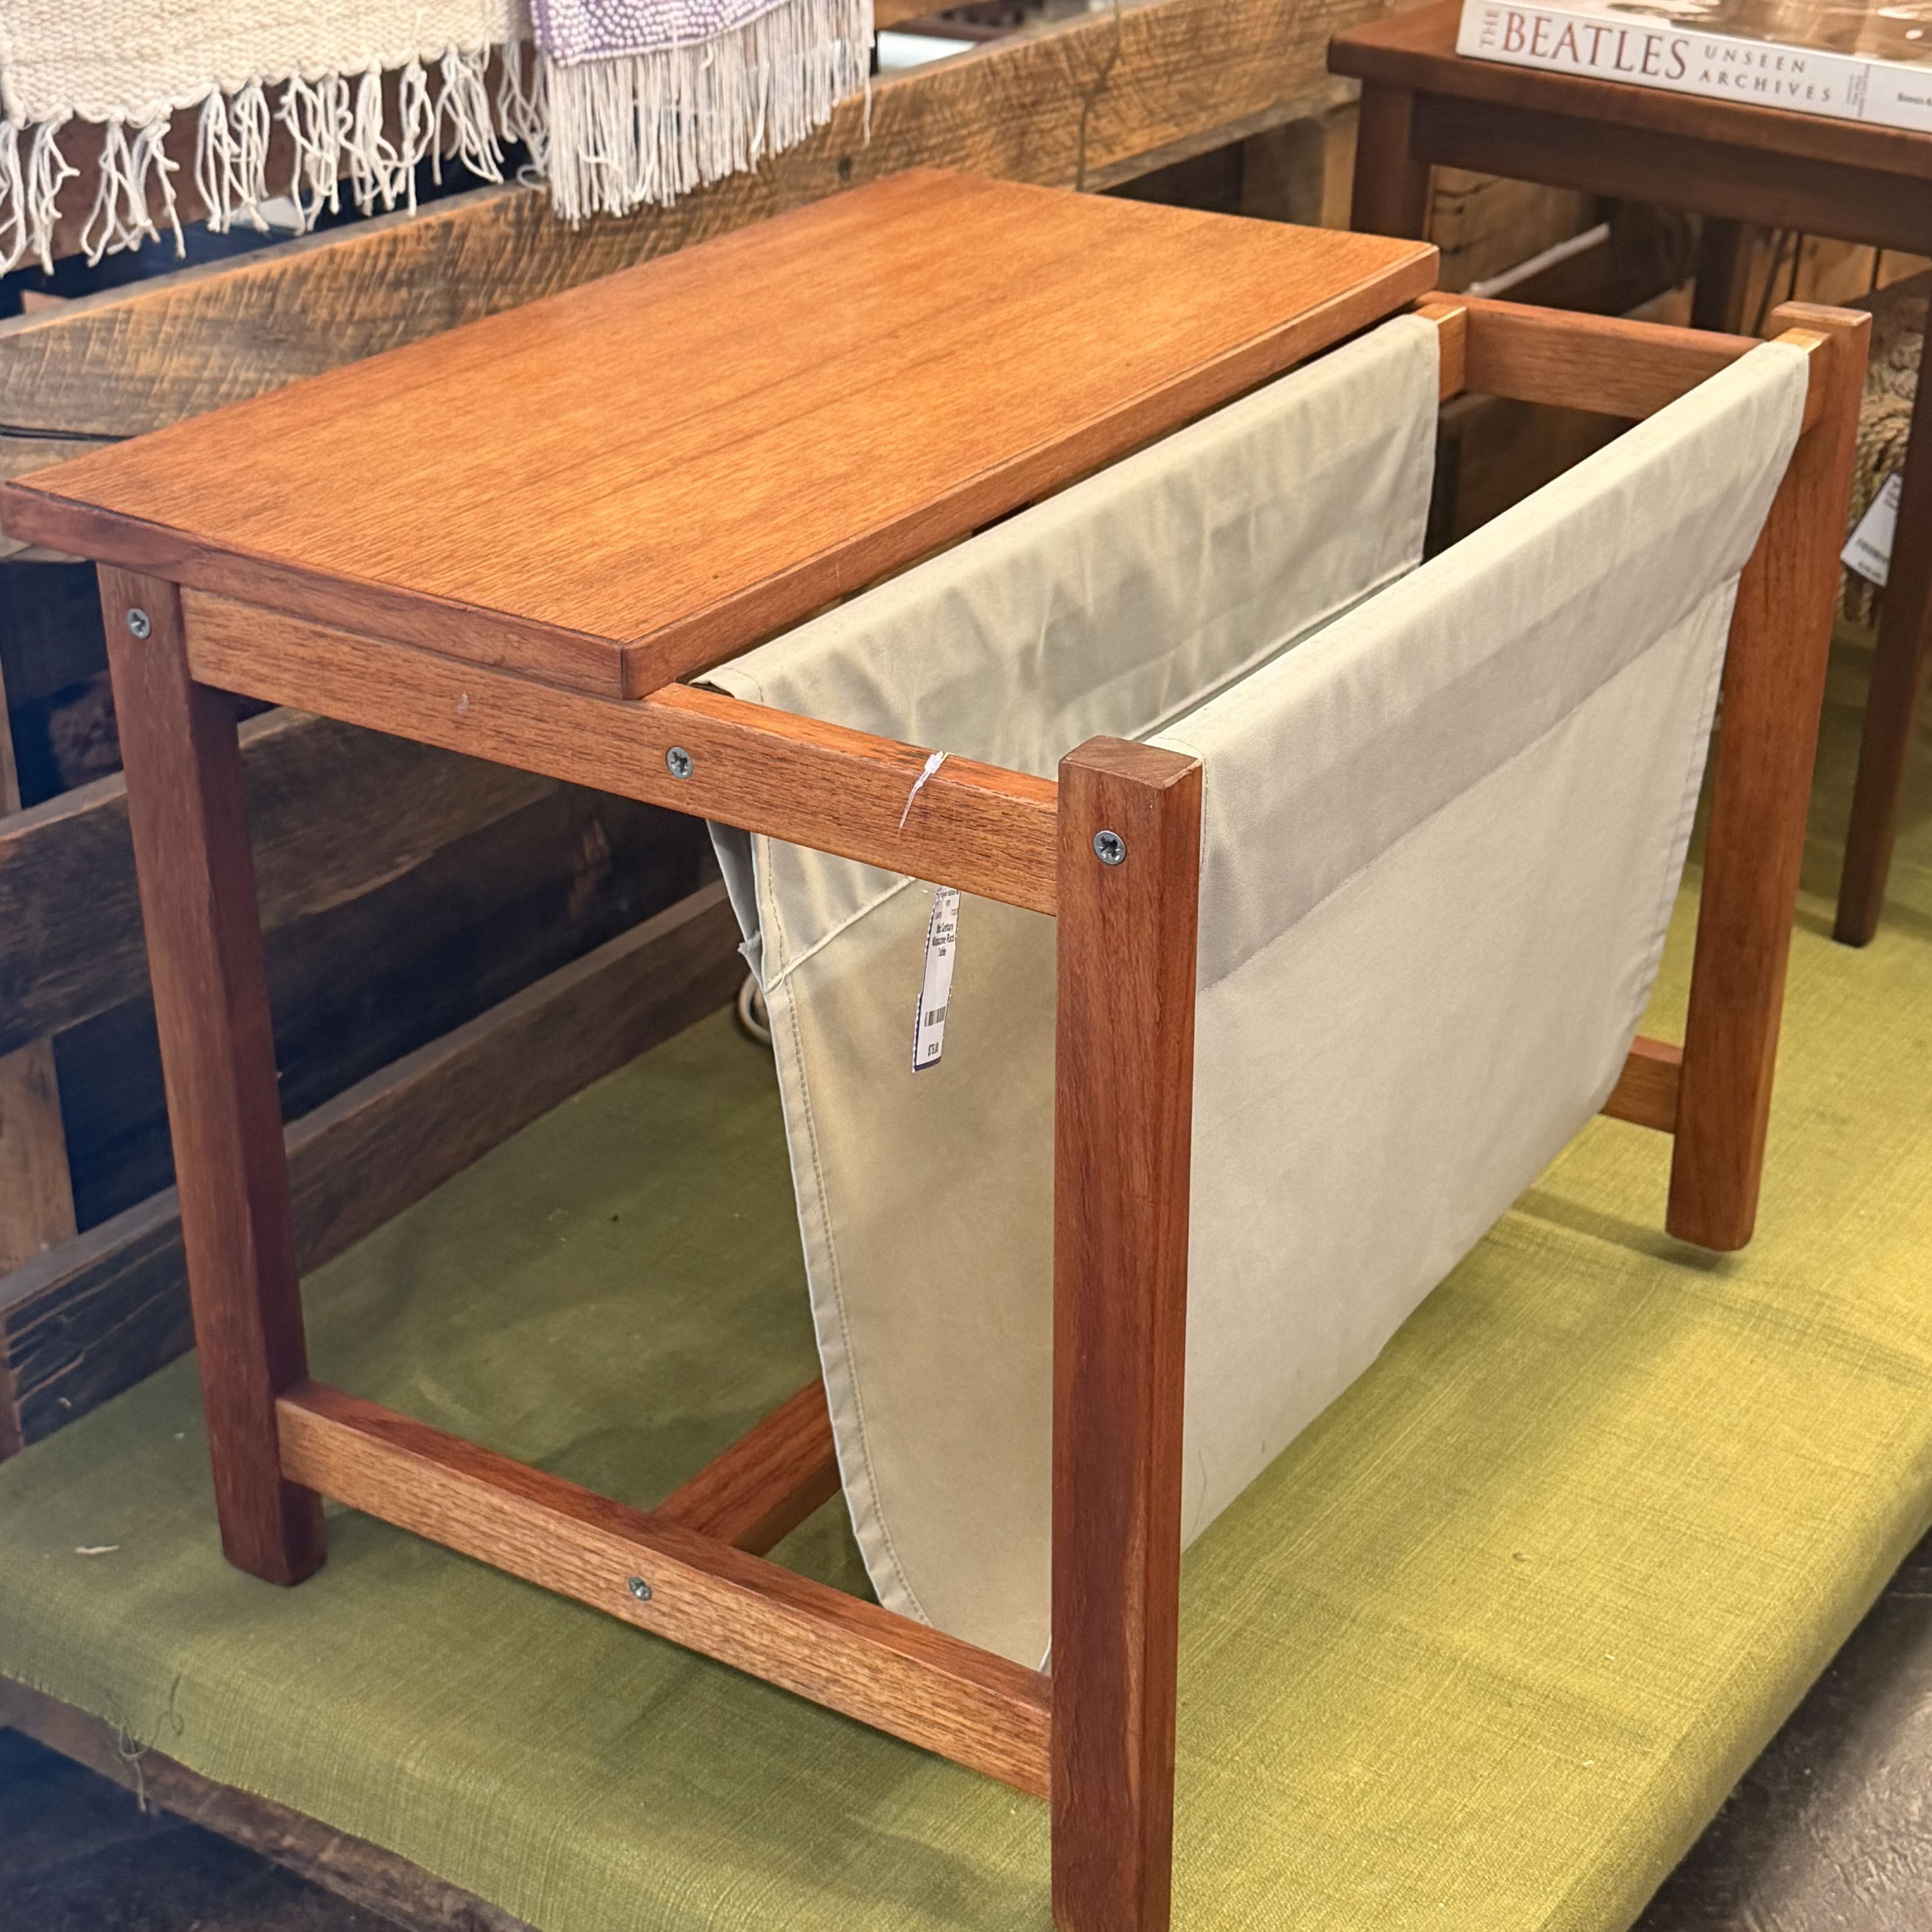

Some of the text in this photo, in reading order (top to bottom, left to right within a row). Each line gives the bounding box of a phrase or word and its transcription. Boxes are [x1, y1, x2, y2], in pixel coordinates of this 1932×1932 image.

[1480, 10, 1500, 46] THE
[1501, 12, 1690, 80] BEATLES
[1704, 45, 1806, 73] UNSEEN
[1699, 68, 1831, 101] ARCHIVES
